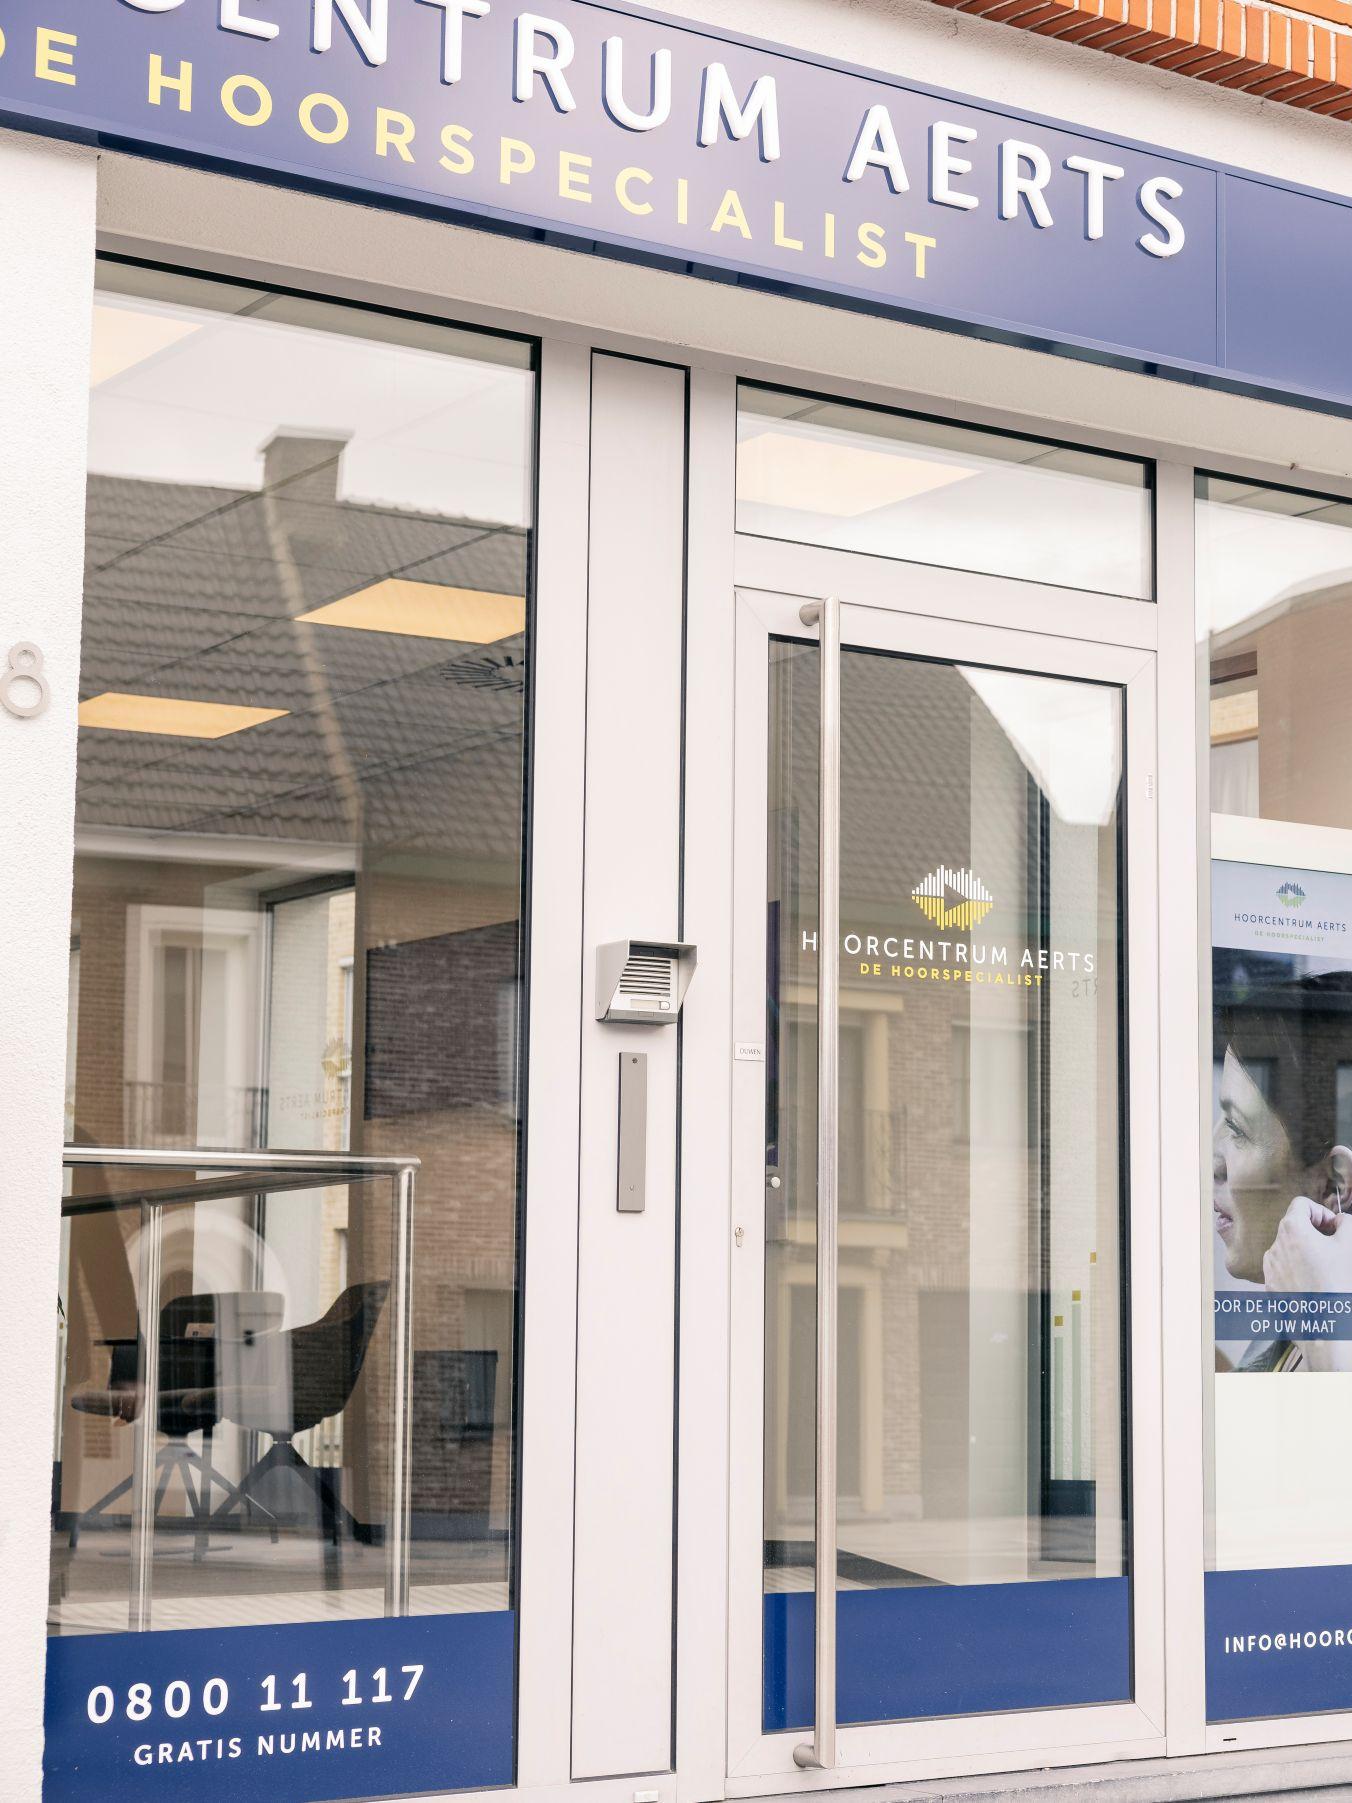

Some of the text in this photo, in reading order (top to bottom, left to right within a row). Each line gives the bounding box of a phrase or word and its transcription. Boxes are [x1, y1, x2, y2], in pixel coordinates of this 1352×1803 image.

[118, 0, 1186, 257] NTRUM AERTS
[0, 26, 937, 279] E HOORSPECIALIST
[0, 641, 50, 719] 8
[1233, 912, 1348, 932] HOORCENTRUM AERTS
[802, 930, 1095, 973] HORCENTRUM AERTS
[860, 962, 1044, 987] DE HOORSPECIALIST
[1245, 1299, 1264, 1313] DE
[1250, 1319, 1337, 1333] OP UW MAAT
[87, 1664, 425, 1724] 0800 11 117
[133, 1726, 383, 1766] GRATIS NUMMER
